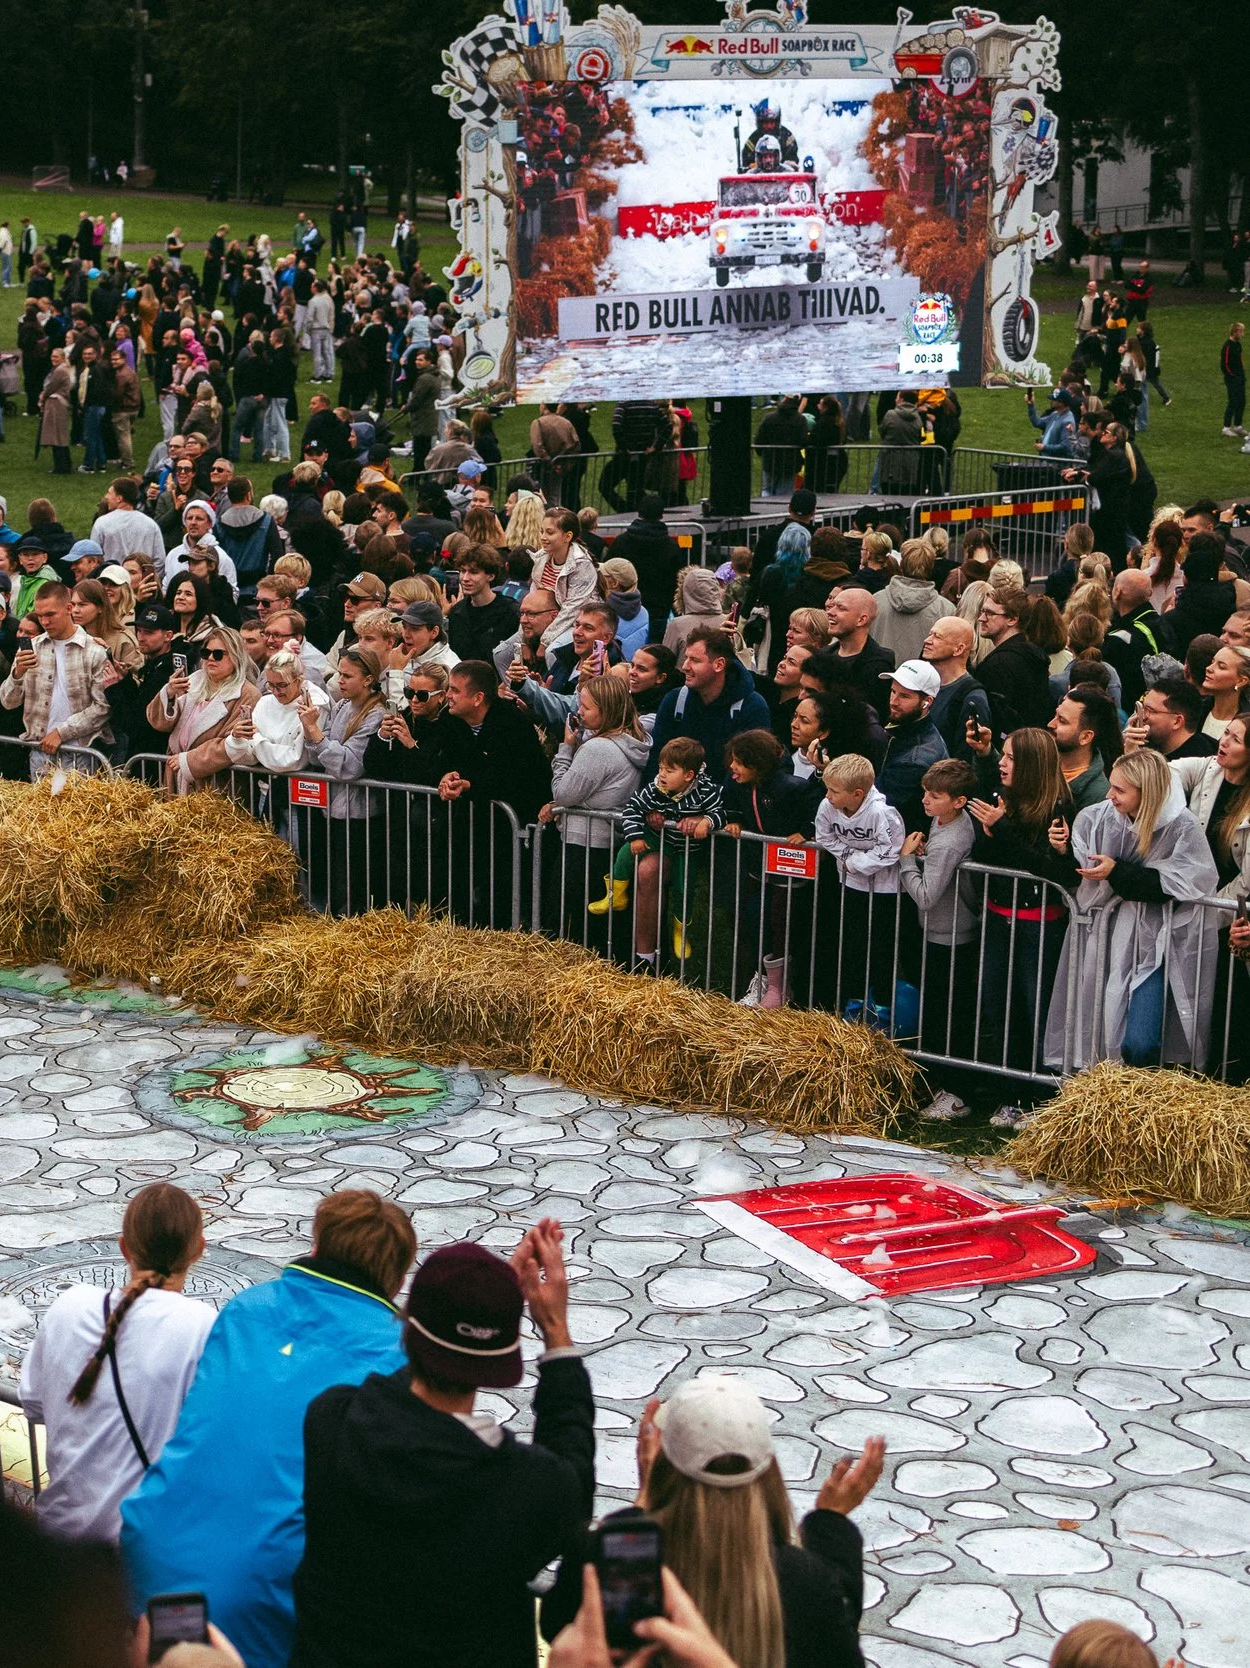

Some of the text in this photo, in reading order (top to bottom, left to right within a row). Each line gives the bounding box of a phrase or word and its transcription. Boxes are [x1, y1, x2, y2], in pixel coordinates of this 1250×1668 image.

[718, 39, 748, 54] Red
[750, 38, 779, 54] Bull
[832, 40, 856, 51] RACE
[595, 300, 640, 332] RED
[648, 296, 703, 329] BULL
[709, 290, 791, 325] ANNAB
[913, 313, 947, 323] Red Bull
[914, 353, 943, 364] 00:38
[778, 849, 806, 859] Boels
